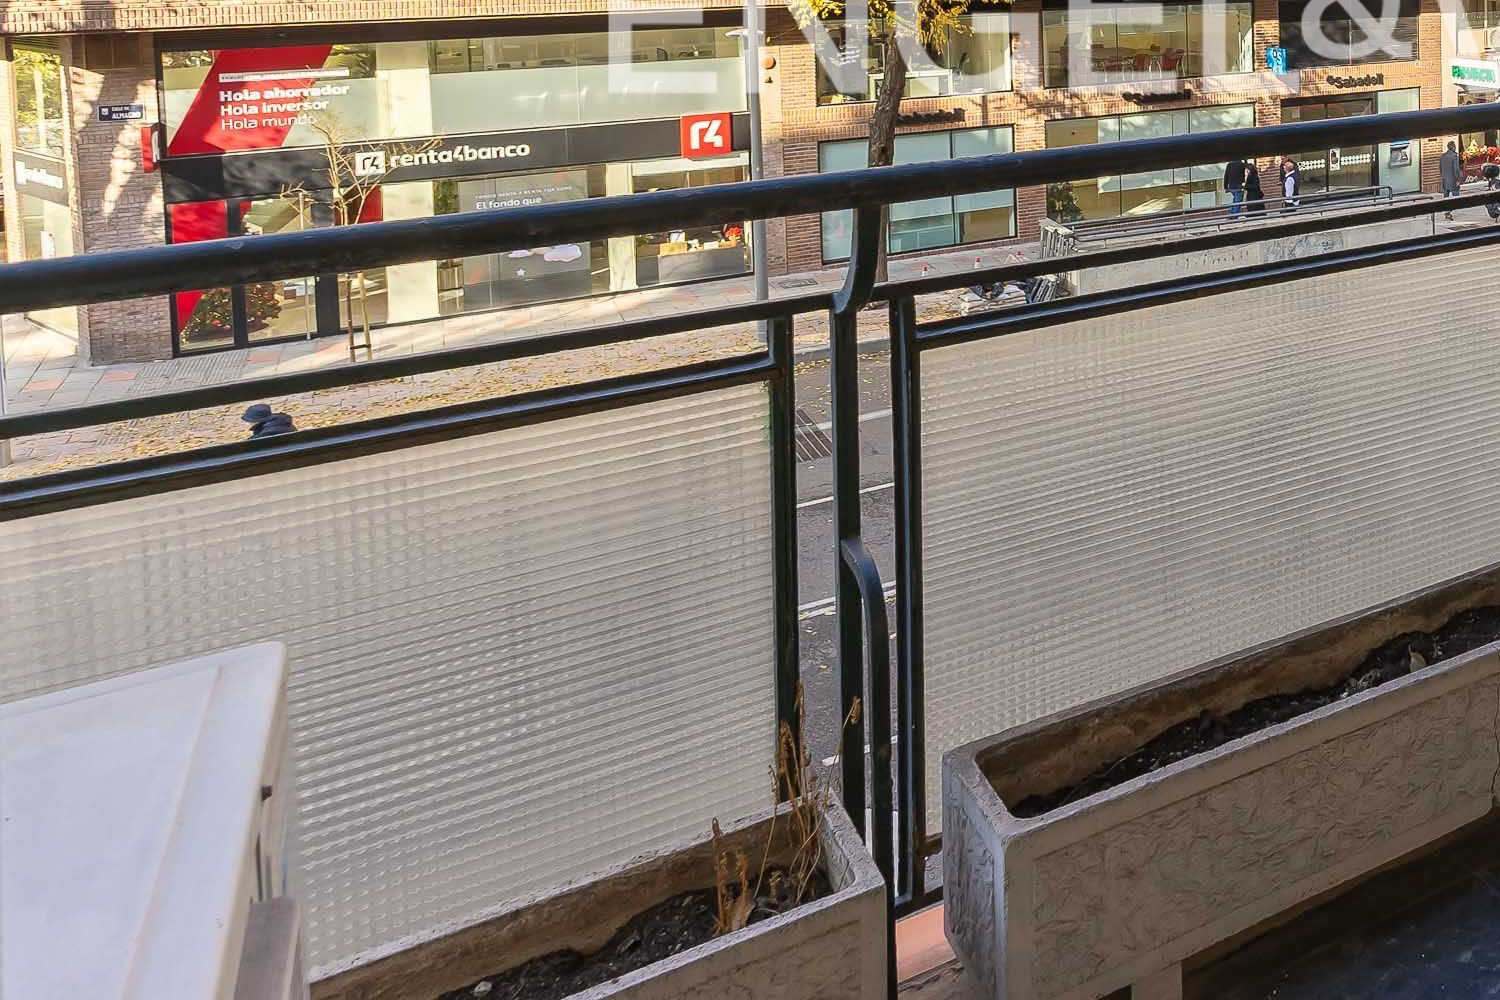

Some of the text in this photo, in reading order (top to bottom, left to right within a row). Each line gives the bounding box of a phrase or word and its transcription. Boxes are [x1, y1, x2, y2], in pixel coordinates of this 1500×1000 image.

[219, 84, 350, 102] Hola ahorrador
[111, 111, 141, 119] ALMAGRO
[220, 100, 329, 116] Hola inversor
[221, 114, 318, 131] Hola mundo
[390, 143, 531, 168] renta4banco
[475, 197, 542, 210] El fondo que
